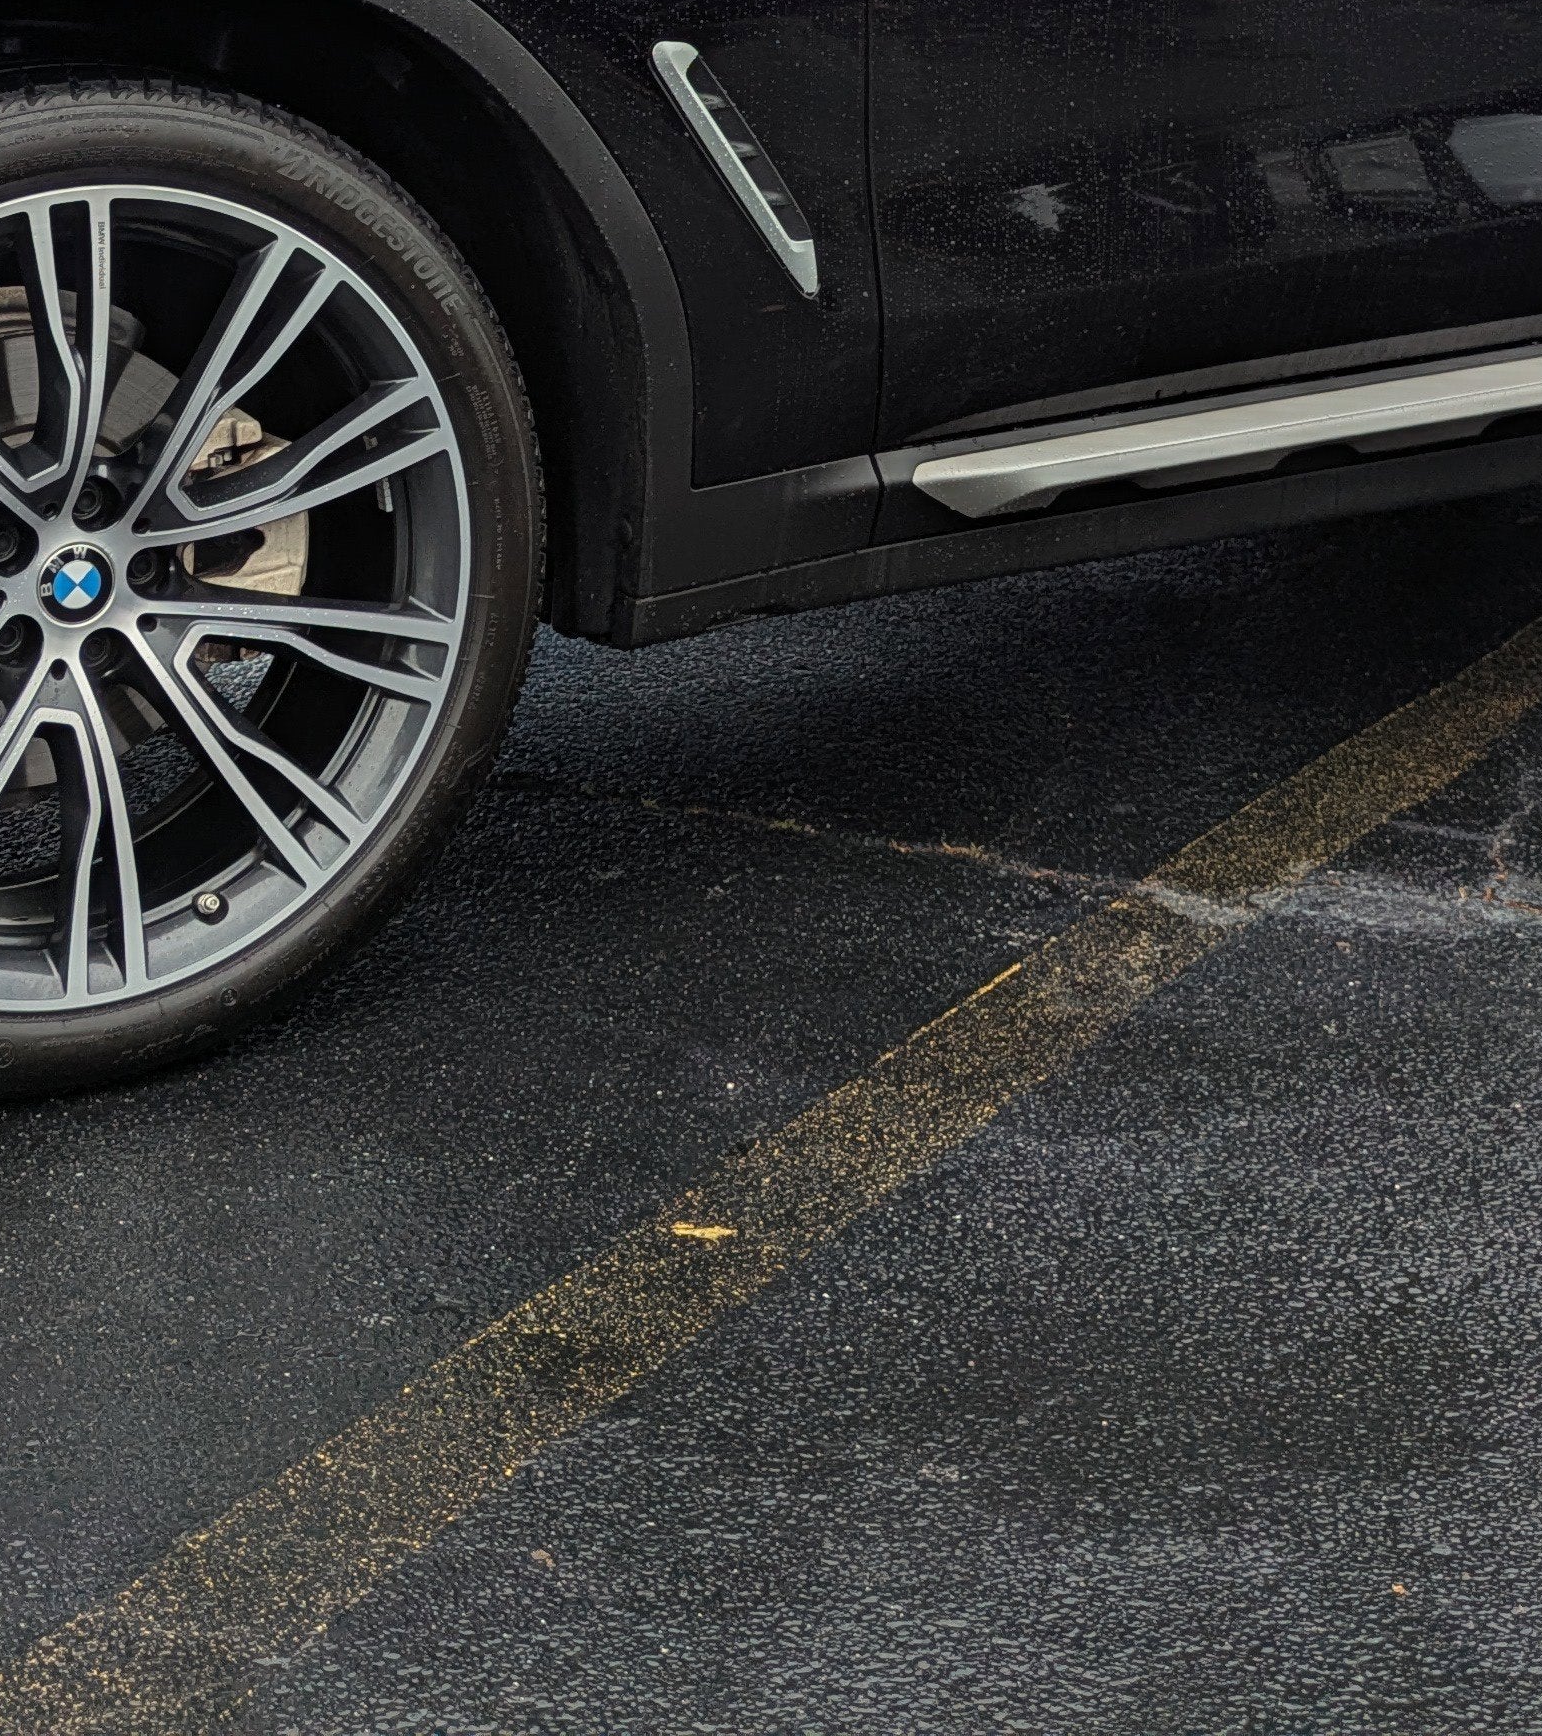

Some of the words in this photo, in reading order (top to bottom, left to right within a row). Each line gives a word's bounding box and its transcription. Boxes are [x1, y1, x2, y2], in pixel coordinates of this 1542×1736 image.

[98, 221, 106, 245] BMW
[276, 151, 471, 317] BRIDGESTONE
[40, 546, 89, 598] BMW
